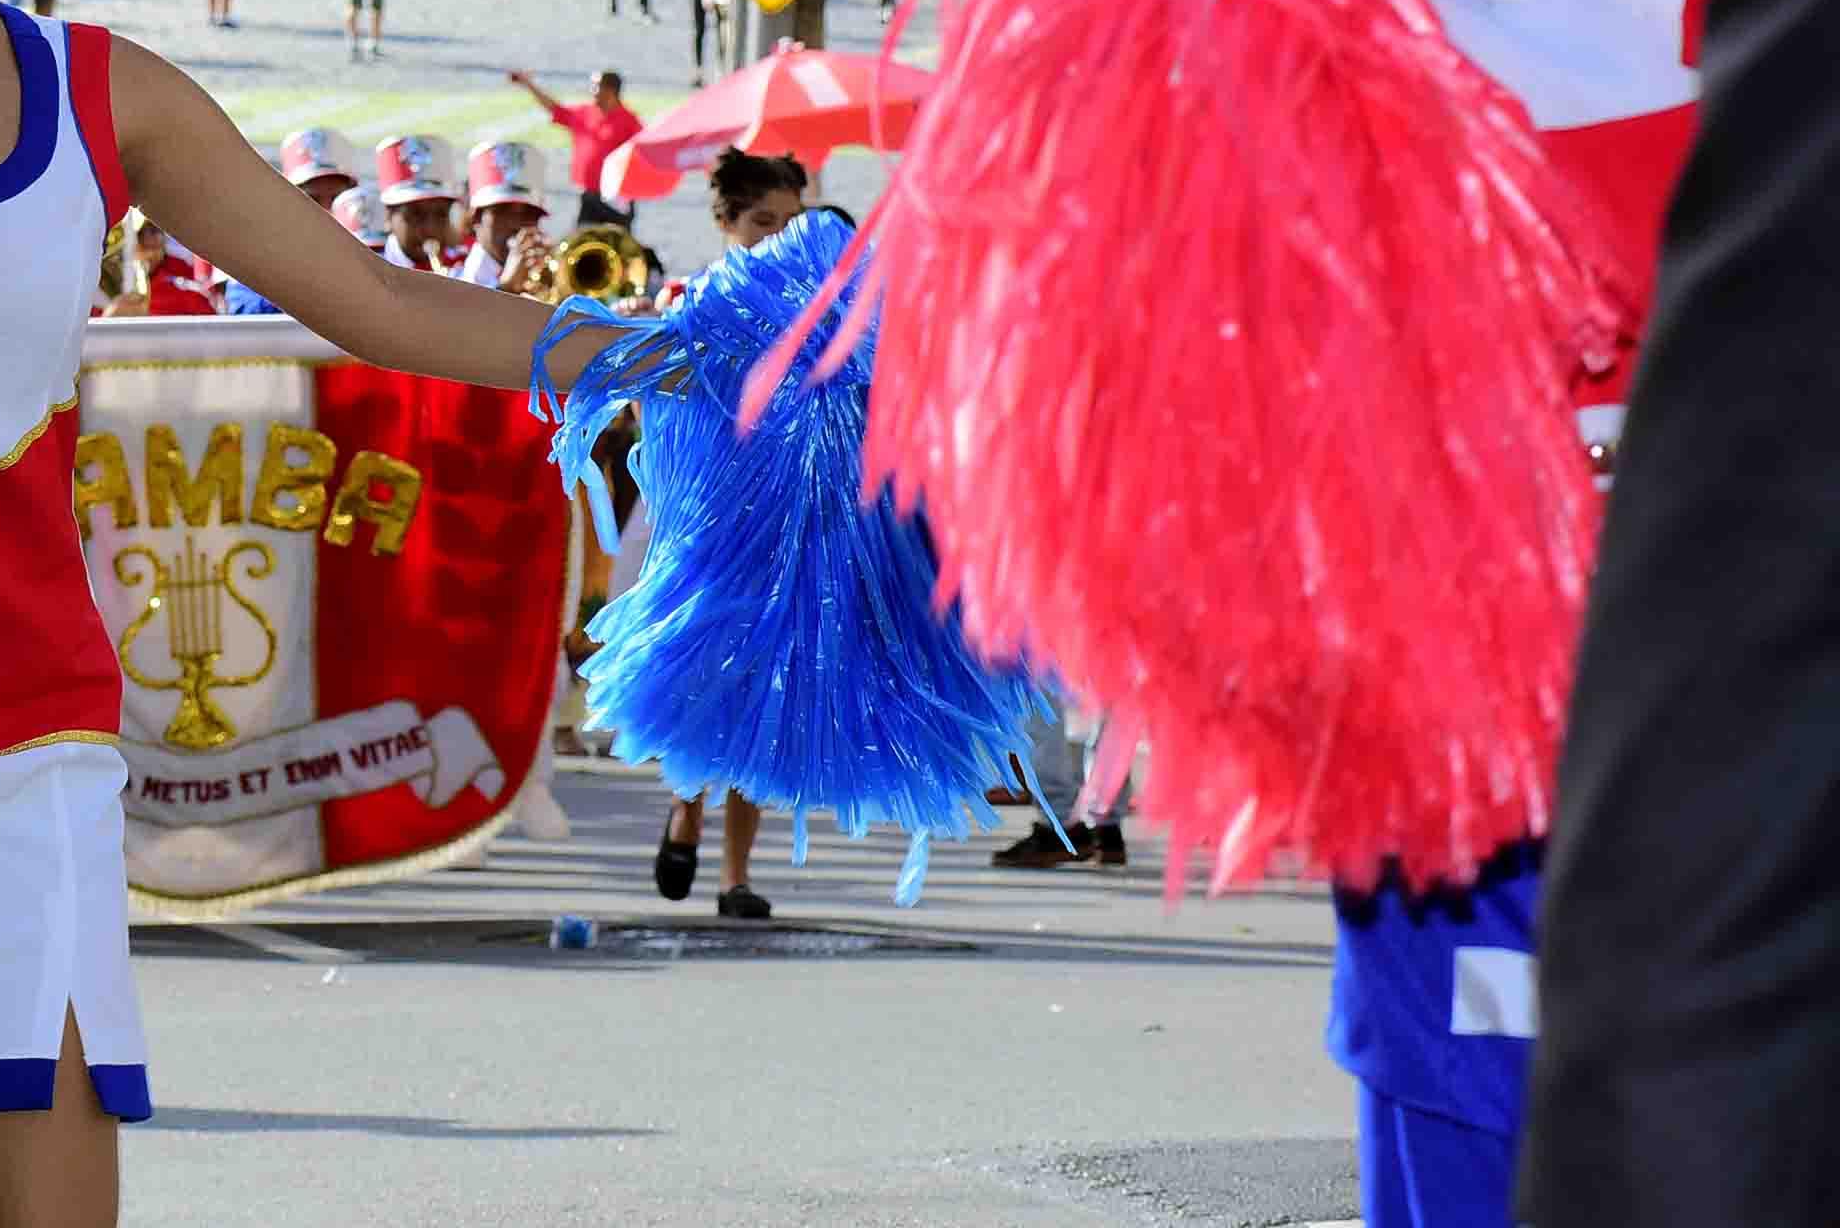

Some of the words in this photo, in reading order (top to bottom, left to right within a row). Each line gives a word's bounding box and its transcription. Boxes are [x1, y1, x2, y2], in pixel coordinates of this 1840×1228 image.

[141, 775, 231, 804] METUS
[239, 767, 272, 795] ET
[349, 725, 429, 770] VITAE
